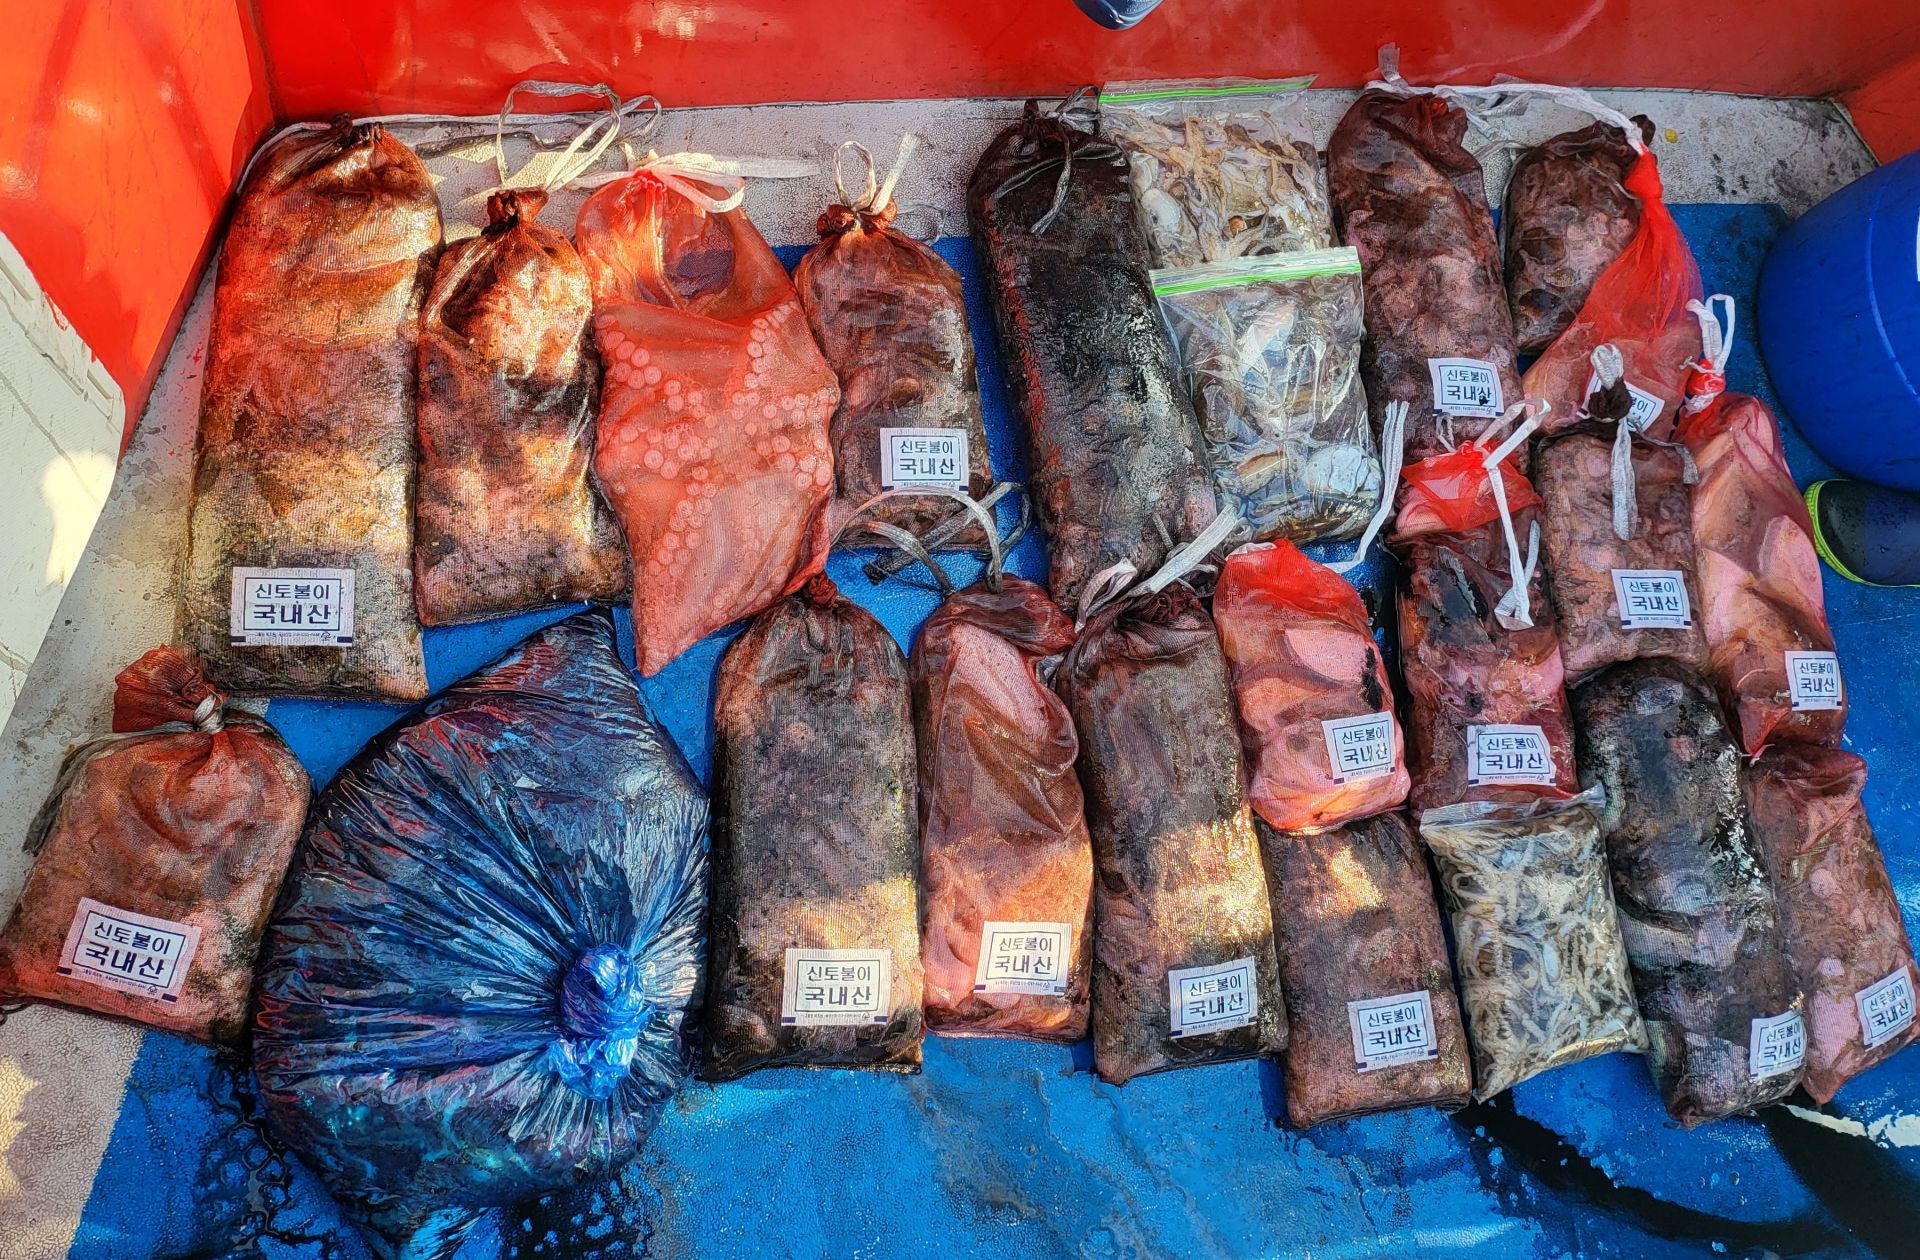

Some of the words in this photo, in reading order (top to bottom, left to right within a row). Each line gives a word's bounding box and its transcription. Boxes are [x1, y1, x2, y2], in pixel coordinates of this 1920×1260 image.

[1447, 370, 1489, 383] 신토불이
[900, 440, 953, 454] 신토불이
[900, 458, 955, 475] 국내산
[255, 583, 329, 600] 신토불이
[1629, 581, 1675, 593] 신토불이
[1632, 596, 1679, 611] 국내산
[253, 604, 331, 624] 국내산
[1800, 663, 1833, 674] 신토불이
[1801, 678, 1835, 692] 국내산
[1342, 726, 1385, 745] 신토불이
[1487, 737, 1538, 750] 신토불이
[1344, 742, 1387, 764] 국내산
[1486, 753, 1543, 770] 국내산
[94, 921, 171, 955] 신토불이
[999, 937, 1052, 952] 신토불이
[85, 940, 164, 980] 국내산
[995, 955, 1052, 975] 국내산
[807, 966, 871, 982] 신토불이
[1189, 974, 1241, 996] 신토불이
[805, 986, 872, 1006] 국내산
[1189, 992, 1244, 1017] 국내산
[1870, 984, 1904, 1011] 신토불이
[1368, 1006, 1416, 1027] 신토불이
[1872, 999, 1909, 1027] 국내산
[1369, 1024, 1421, 1048] 국내산
[1767, 1021, 1800, 1043] 신토불이
[1764, 1037, 1801, 1061] 국내산
